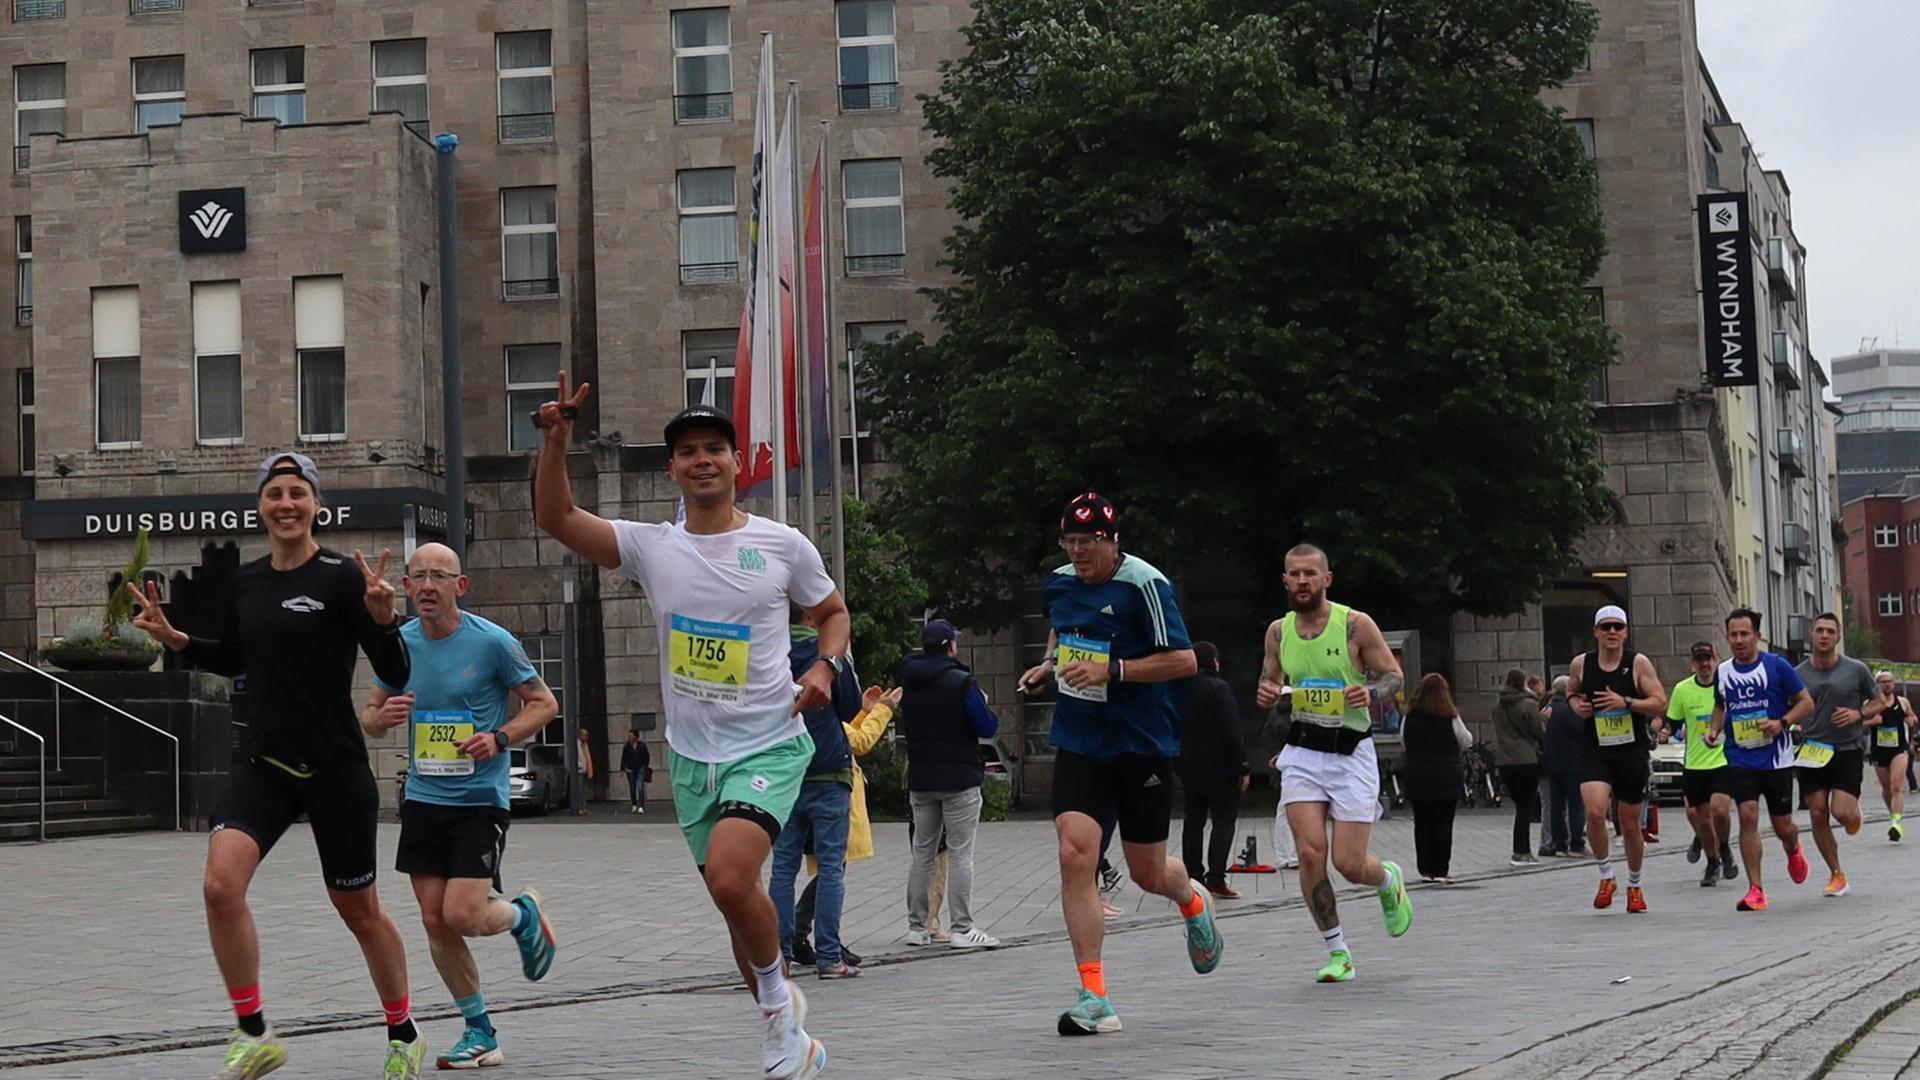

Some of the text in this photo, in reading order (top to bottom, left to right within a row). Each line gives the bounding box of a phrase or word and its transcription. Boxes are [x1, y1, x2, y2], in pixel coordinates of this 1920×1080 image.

[1716, 239, 1744, 378] WYNDHAM
[85, 506, 351, 534] DUISBURGE OF
[687, 636, 726, 662] 1756
[1304, 689, 1330, 703] 1213
[1737, 686, 1755, 699] LC
[428, 725, 457, 742] 2532
